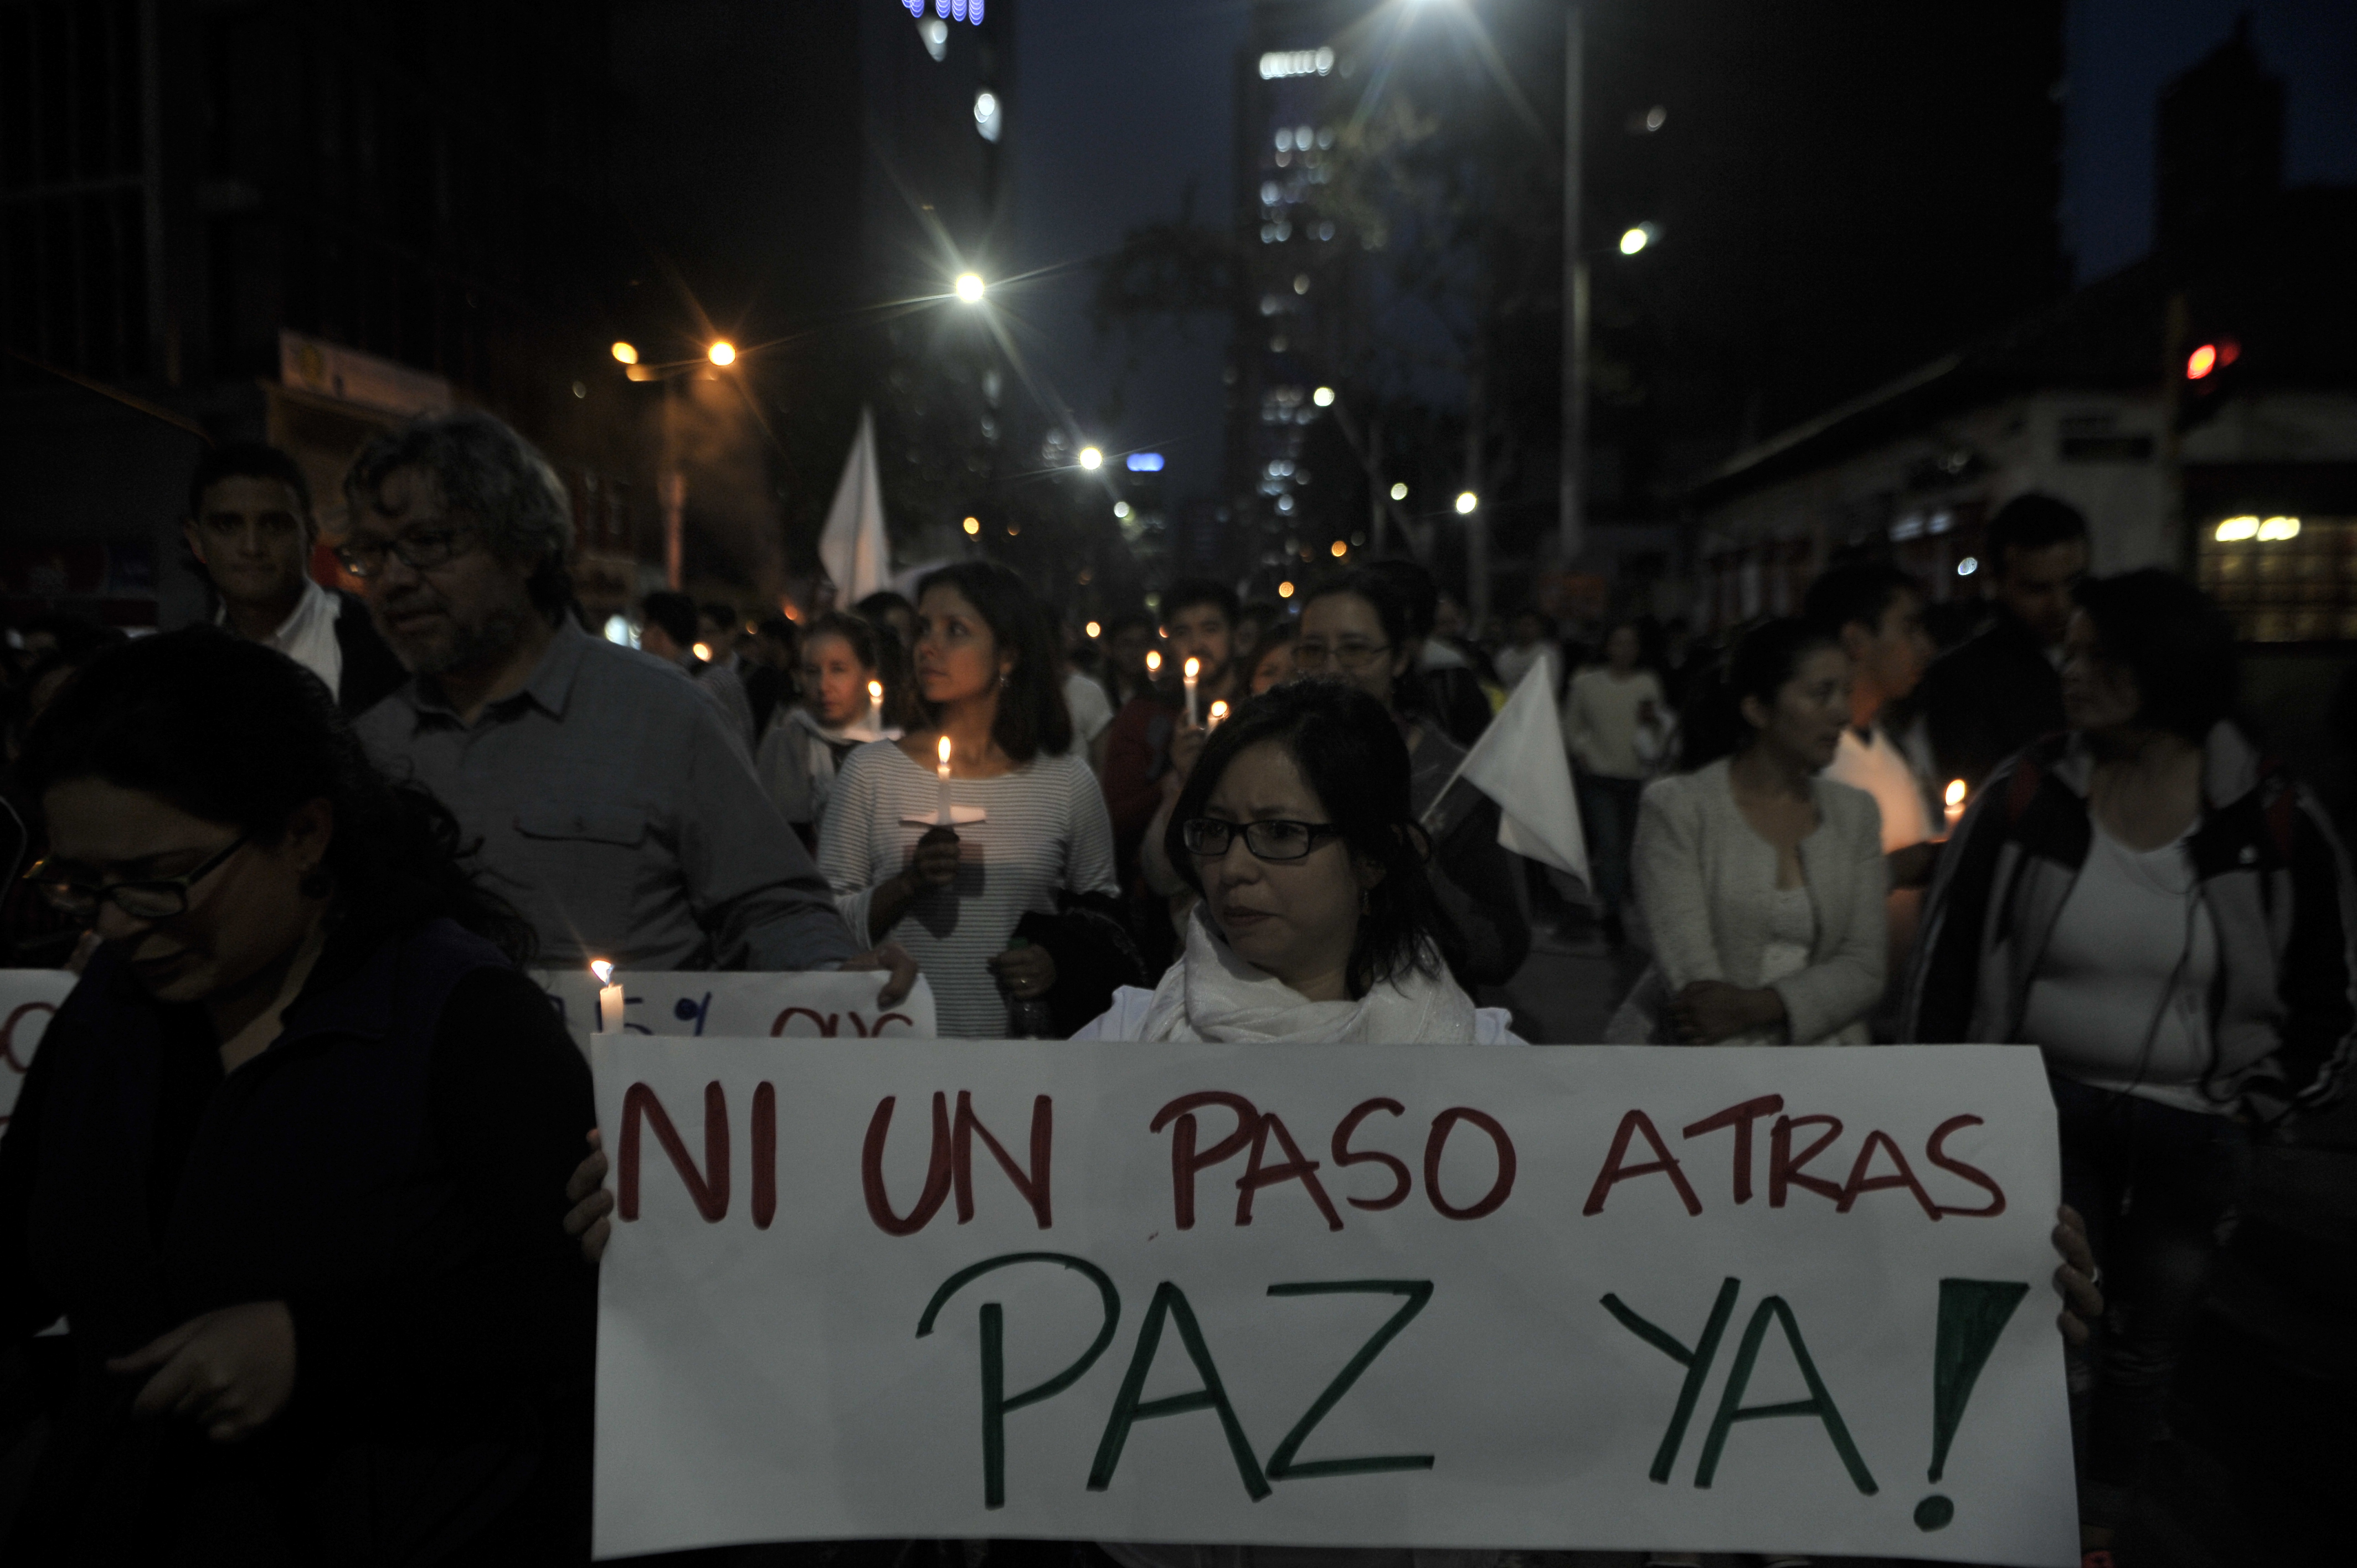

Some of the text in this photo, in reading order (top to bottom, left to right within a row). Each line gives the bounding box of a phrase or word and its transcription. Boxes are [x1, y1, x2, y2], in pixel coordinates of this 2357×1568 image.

[616, 1080, 2006, 1237] NI UN PASO ATRAS
[916, 1252, 2032, 1532] PAZ YA!
